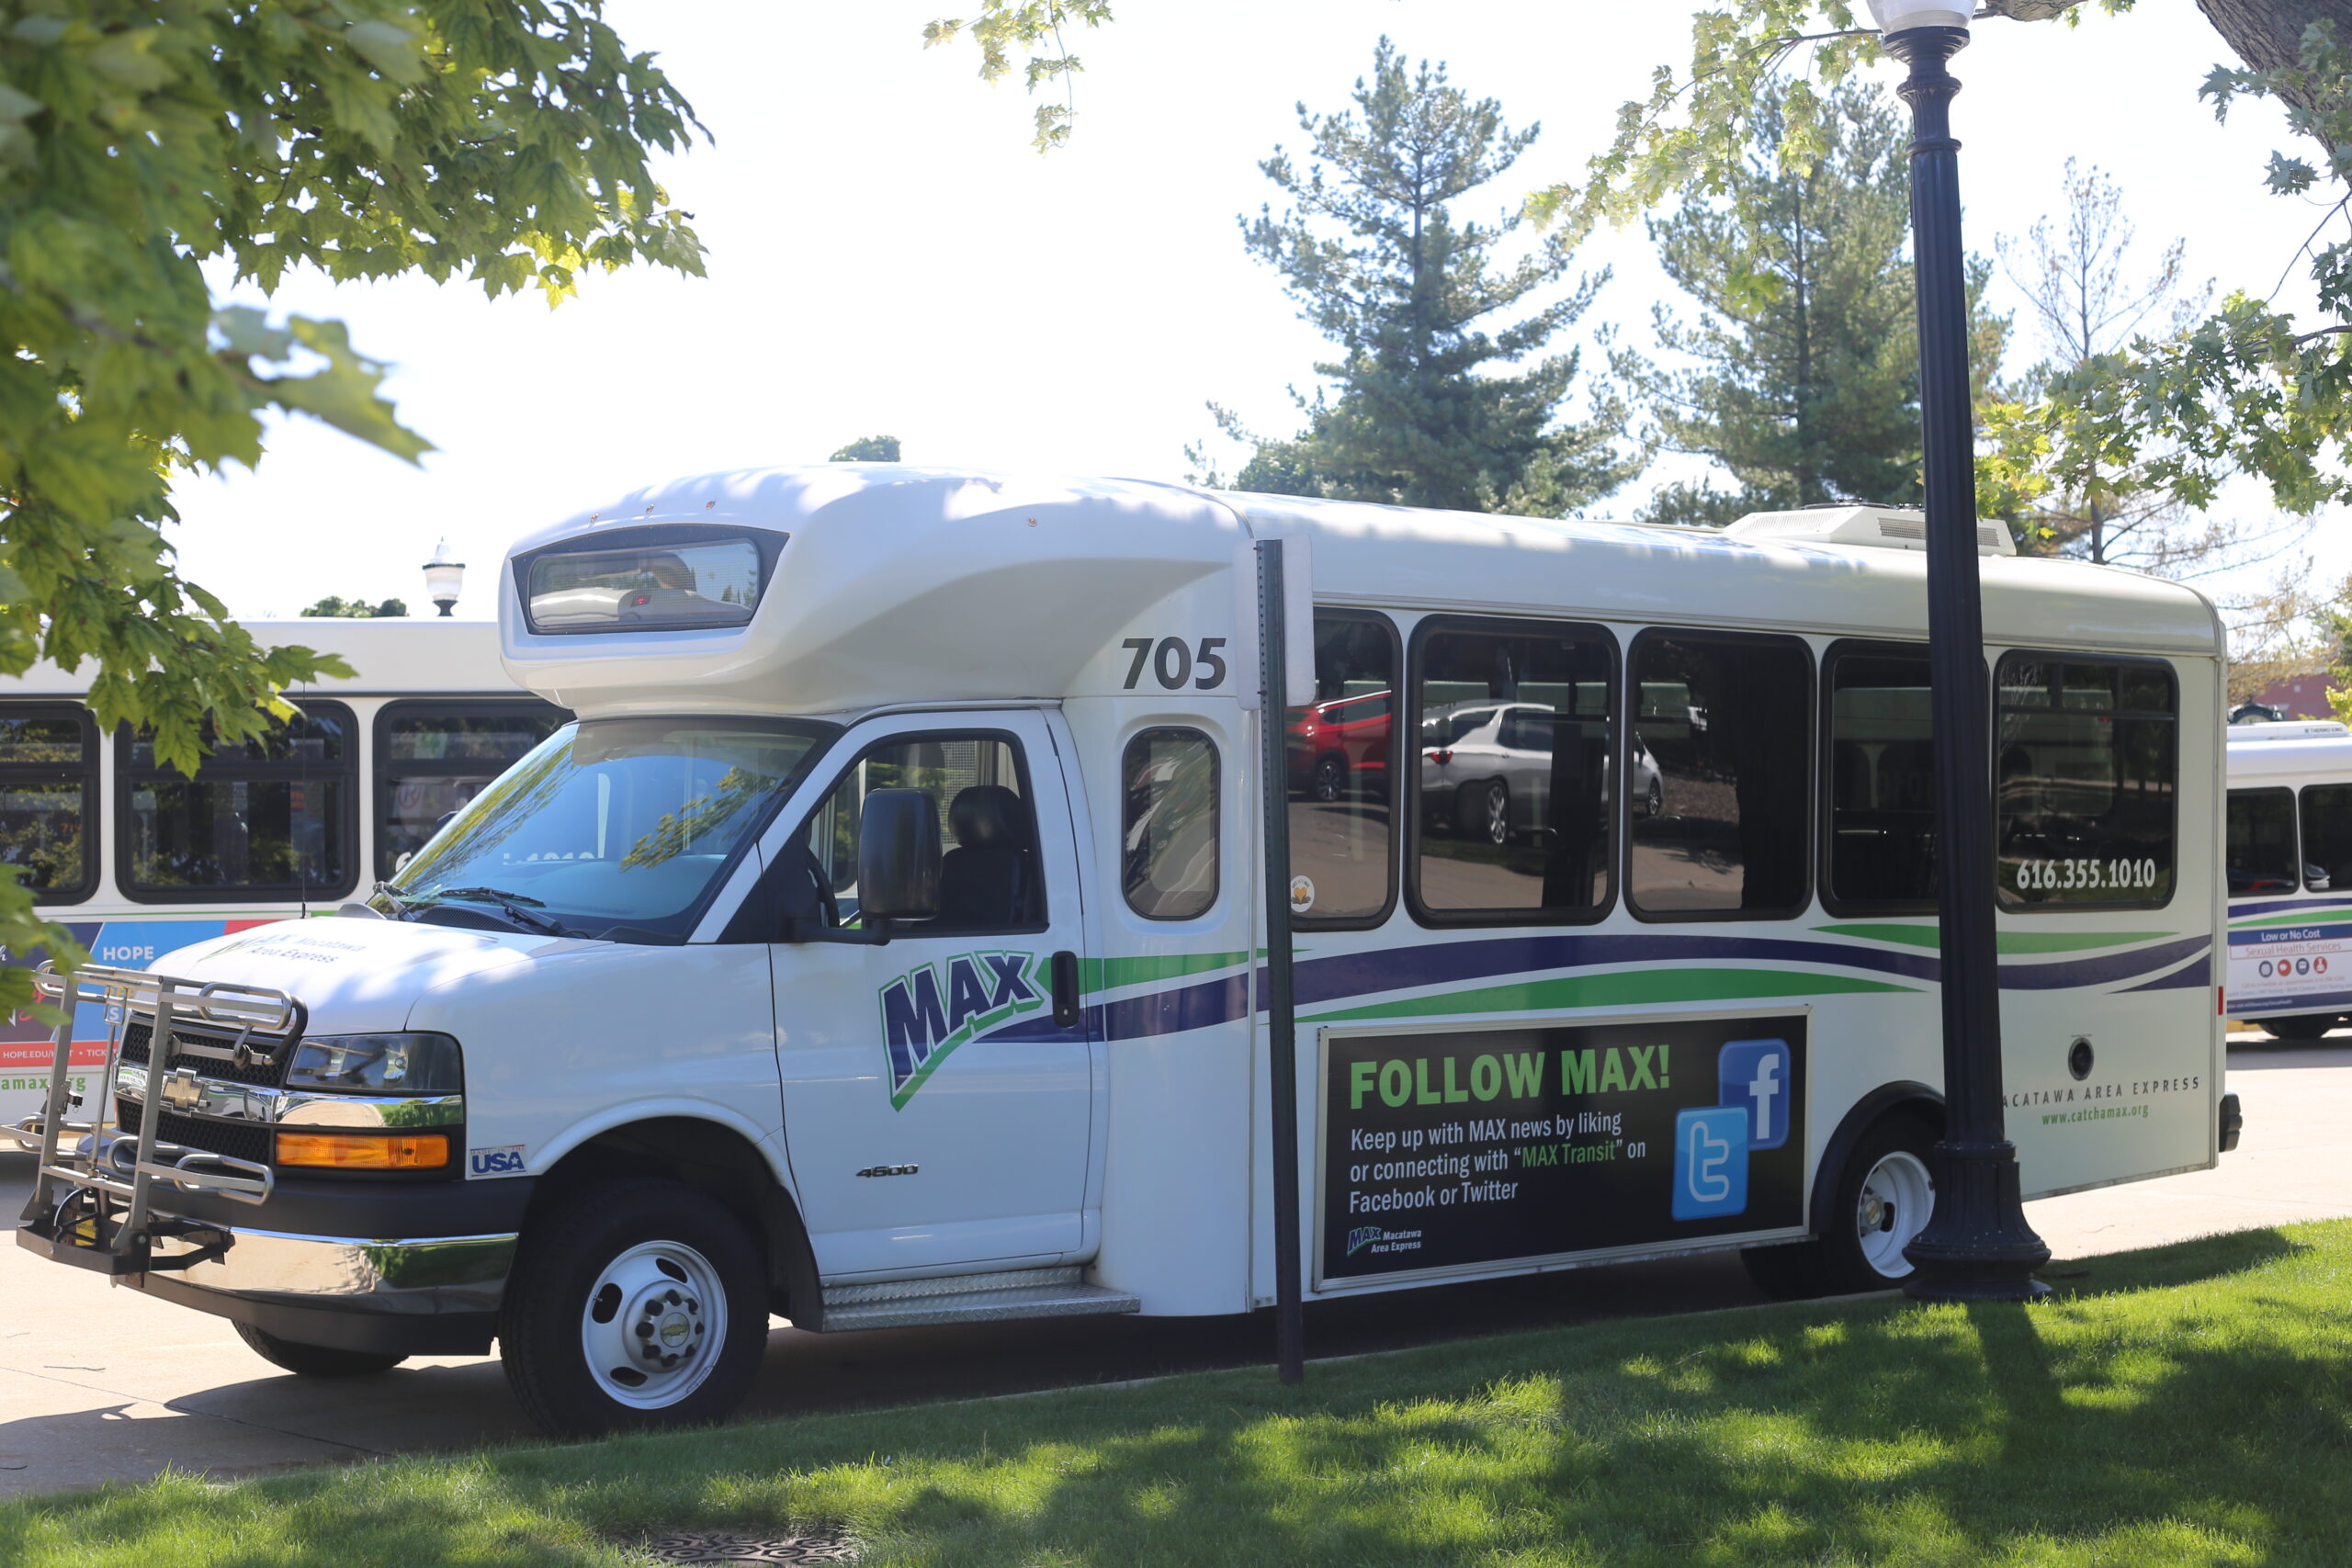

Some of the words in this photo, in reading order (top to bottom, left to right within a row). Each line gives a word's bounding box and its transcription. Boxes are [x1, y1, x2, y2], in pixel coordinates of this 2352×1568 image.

[1122, 637, 1227, 690] 705
[2017, 858, 2156, 889] 616.355.1010
[2245, 946, 2275, 956] Sexual
[2277, 942, 2305, 953] Health
[2306, 941, 2342, 952] Services
[2261, 931, 2278, 942] Low
[2279, 932, 2289, 941] or
[2290, 930, 2301, 940] No
[2302, 929, 2321, 939] Cost
[103, 946, 154, 961] HOPE
[879, 949, 1044, 1108] MAX
[1351, 1052, 1545, 1110] FOLLOW
[1561, 1044, 1670, 1096] MAX!
[2003, 1089, 2074, 1109] ACATAWA
[2085, 1084, 2122, 1100] AREA
[2132, 1076, 2199, 1096] EXPRESS
[2041, 1104, 2149, 1126] www.catchamax.org
[1351, 1126, 1396, 1153] Keep
[1401, 1128, 1424, 1151] up
[1429, 1122, 1464, 1145] with
[1469, 1119, 1507, 1142] MAX
[1510, 1120, 1553, 1138] news
[1555, 1115, 1574, 1137] by
[1578, 1111, 1623, 1136] liking
[472, 1152, 525, 1173] USA
[855, 1163, 919, 1178] 4500
[1350, 1164, 1369, 1182] or
[1374, 1153, 1470, 1180] connecting
[1474, 1151, 1509, 1175] with
[1627, 1140, 1646, 1159] on
[1350, 1185, 1435, 1213] Facebook
[1440, 1186, 1457, 1206] or
[1462, 1180, 1518, 1203] Twitter
[1347, 1226, 1381, 1256] MAX
[1371, 1243, 1389, 1254] Area
[1391, 1240, 1421, 1253] Express
[1383, 1229, 1422, 1241] Macatawa
